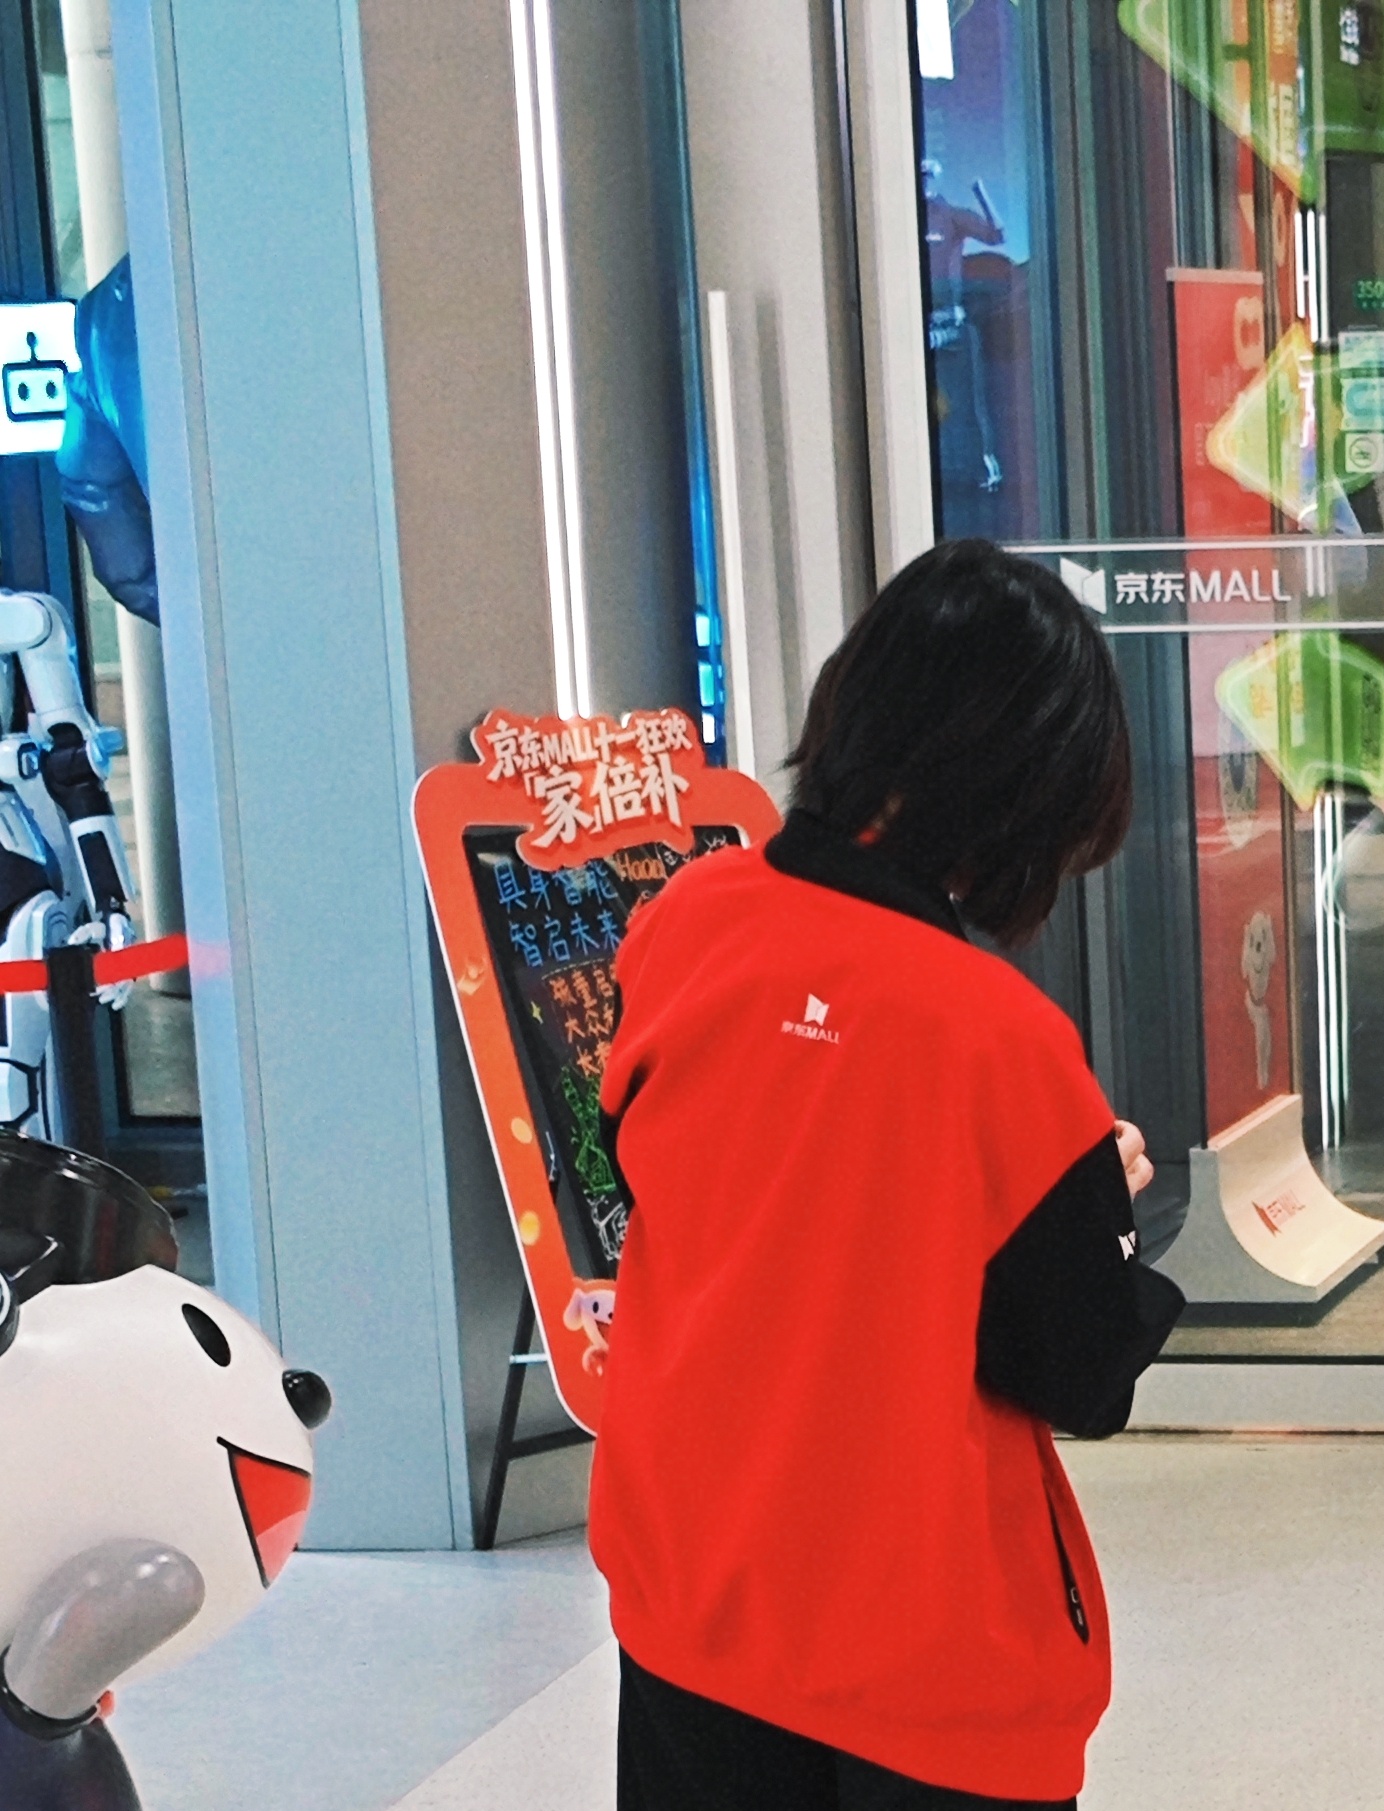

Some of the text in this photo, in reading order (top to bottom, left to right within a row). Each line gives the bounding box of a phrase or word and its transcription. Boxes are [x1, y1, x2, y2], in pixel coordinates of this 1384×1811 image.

[1114, 568, 1292, 605] 京东MALL
[485, 713, 693, 782] 京东MALL十一狂欢
[509, 909, 622, 968] 智启未来
